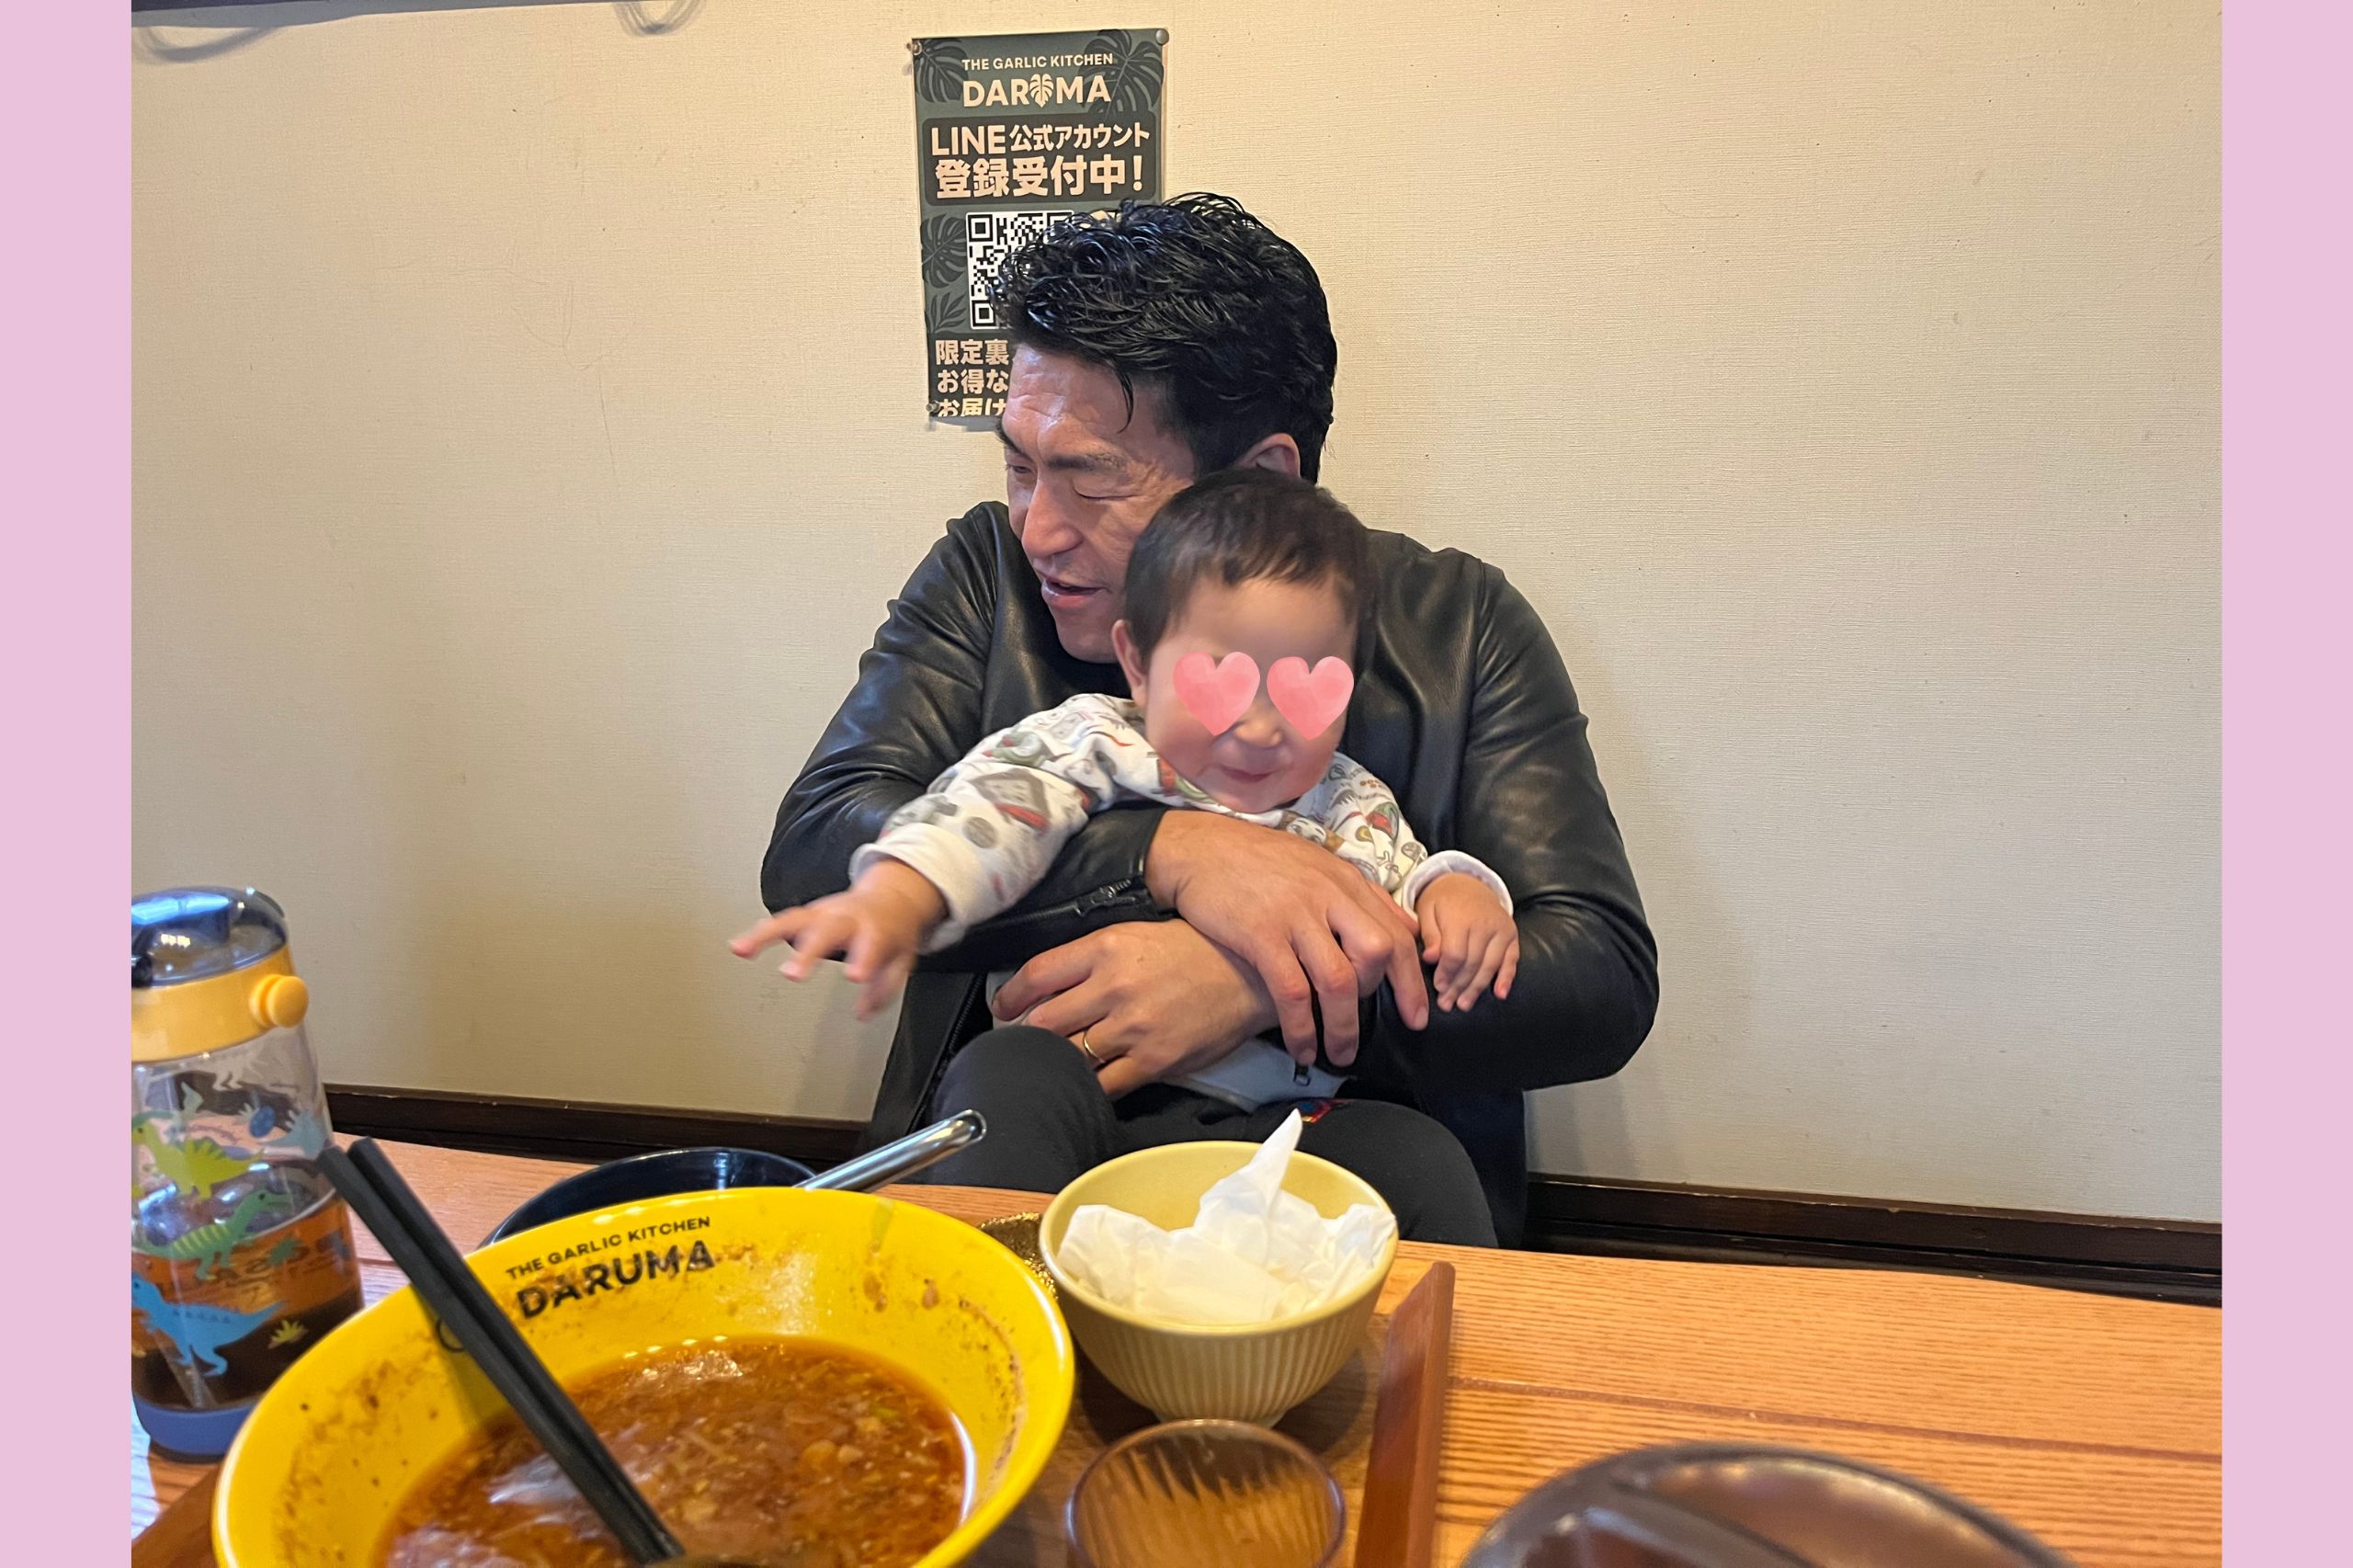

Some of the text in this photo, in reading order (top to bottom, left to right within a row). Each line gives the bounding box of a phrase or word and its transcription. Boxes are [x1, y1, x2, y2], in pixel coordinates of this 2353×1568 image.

[962, 53, 1114, 71] THE GARLIC KITCHEN
[935, 153, 1142, 199] 登録受付中!
[935, 339, 1009, 366] 限定裏
[938, 369, 1009, 394] お得な
[506, 1216, 711, 1280] THE GARLIC KITCHEN
[515, 1240, 715, 1319] DARUMA
